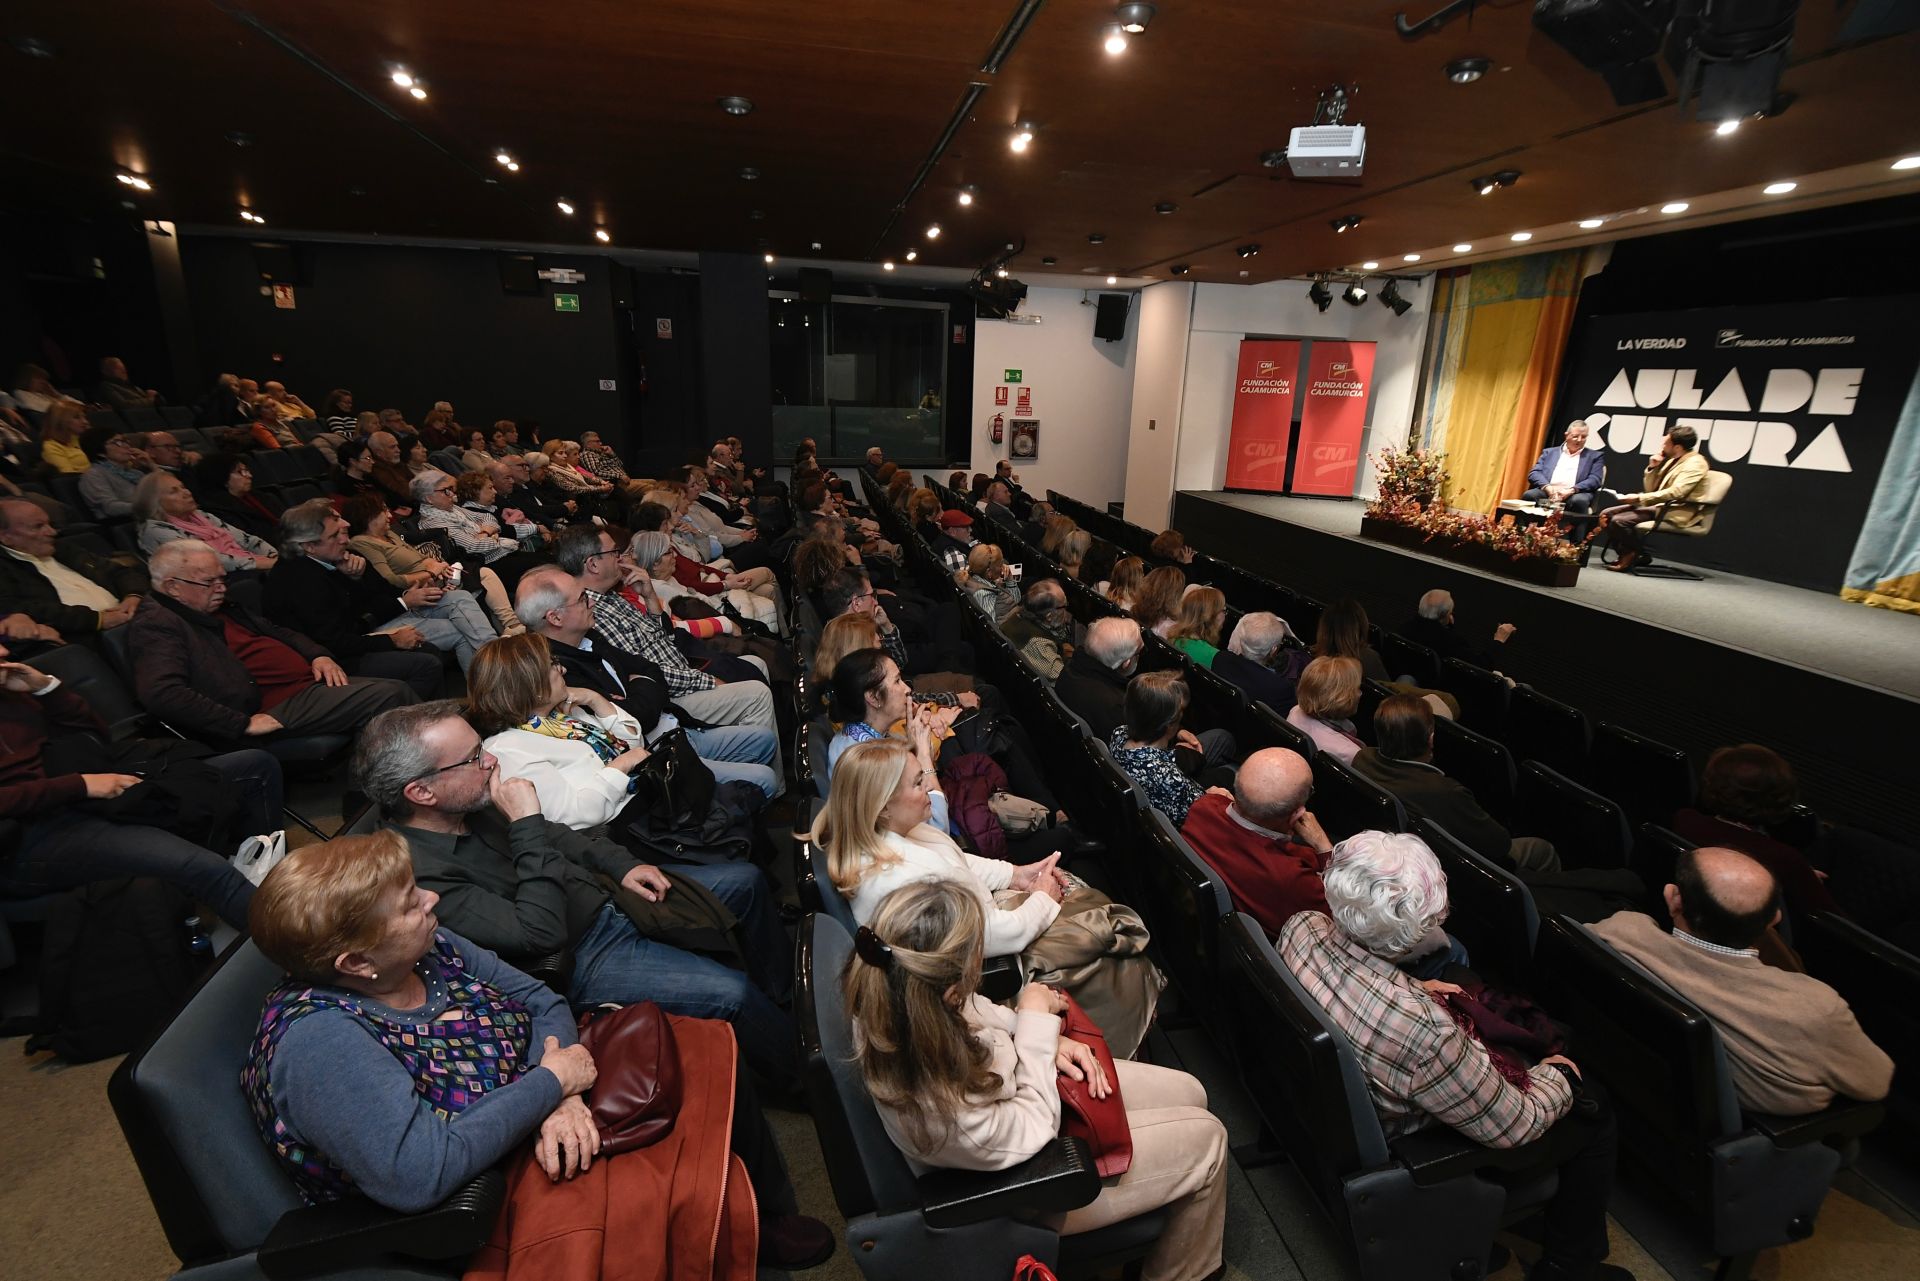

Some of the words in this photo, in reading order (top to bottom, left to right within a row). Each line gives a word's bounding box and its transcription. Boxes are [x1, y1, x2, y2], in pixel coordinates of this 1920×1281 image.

[1617, 339, 1633, 351] LA
[1634, 338, 1687, 350] VERDAD
[1735, 337, 1788, 348] FUNDACIÓN
[1790, 335, 1856, 346] CAJAMURCIA
[1243, 379, 1289, 387] FUNDACIÓN
[1313, 381, 1363, 389] FUNDACIÓN
[1240, 387, 1290, 395] CAJAMURCIA
[1310, 389, 1364, 397] CAJAMURCIA
[1594, 366, 1751, 412] AULA
[1758, 368, 1865, 416] DE
[1244, 443, 1275, 456] CM
[1313, 446, 1347, 460] CM
